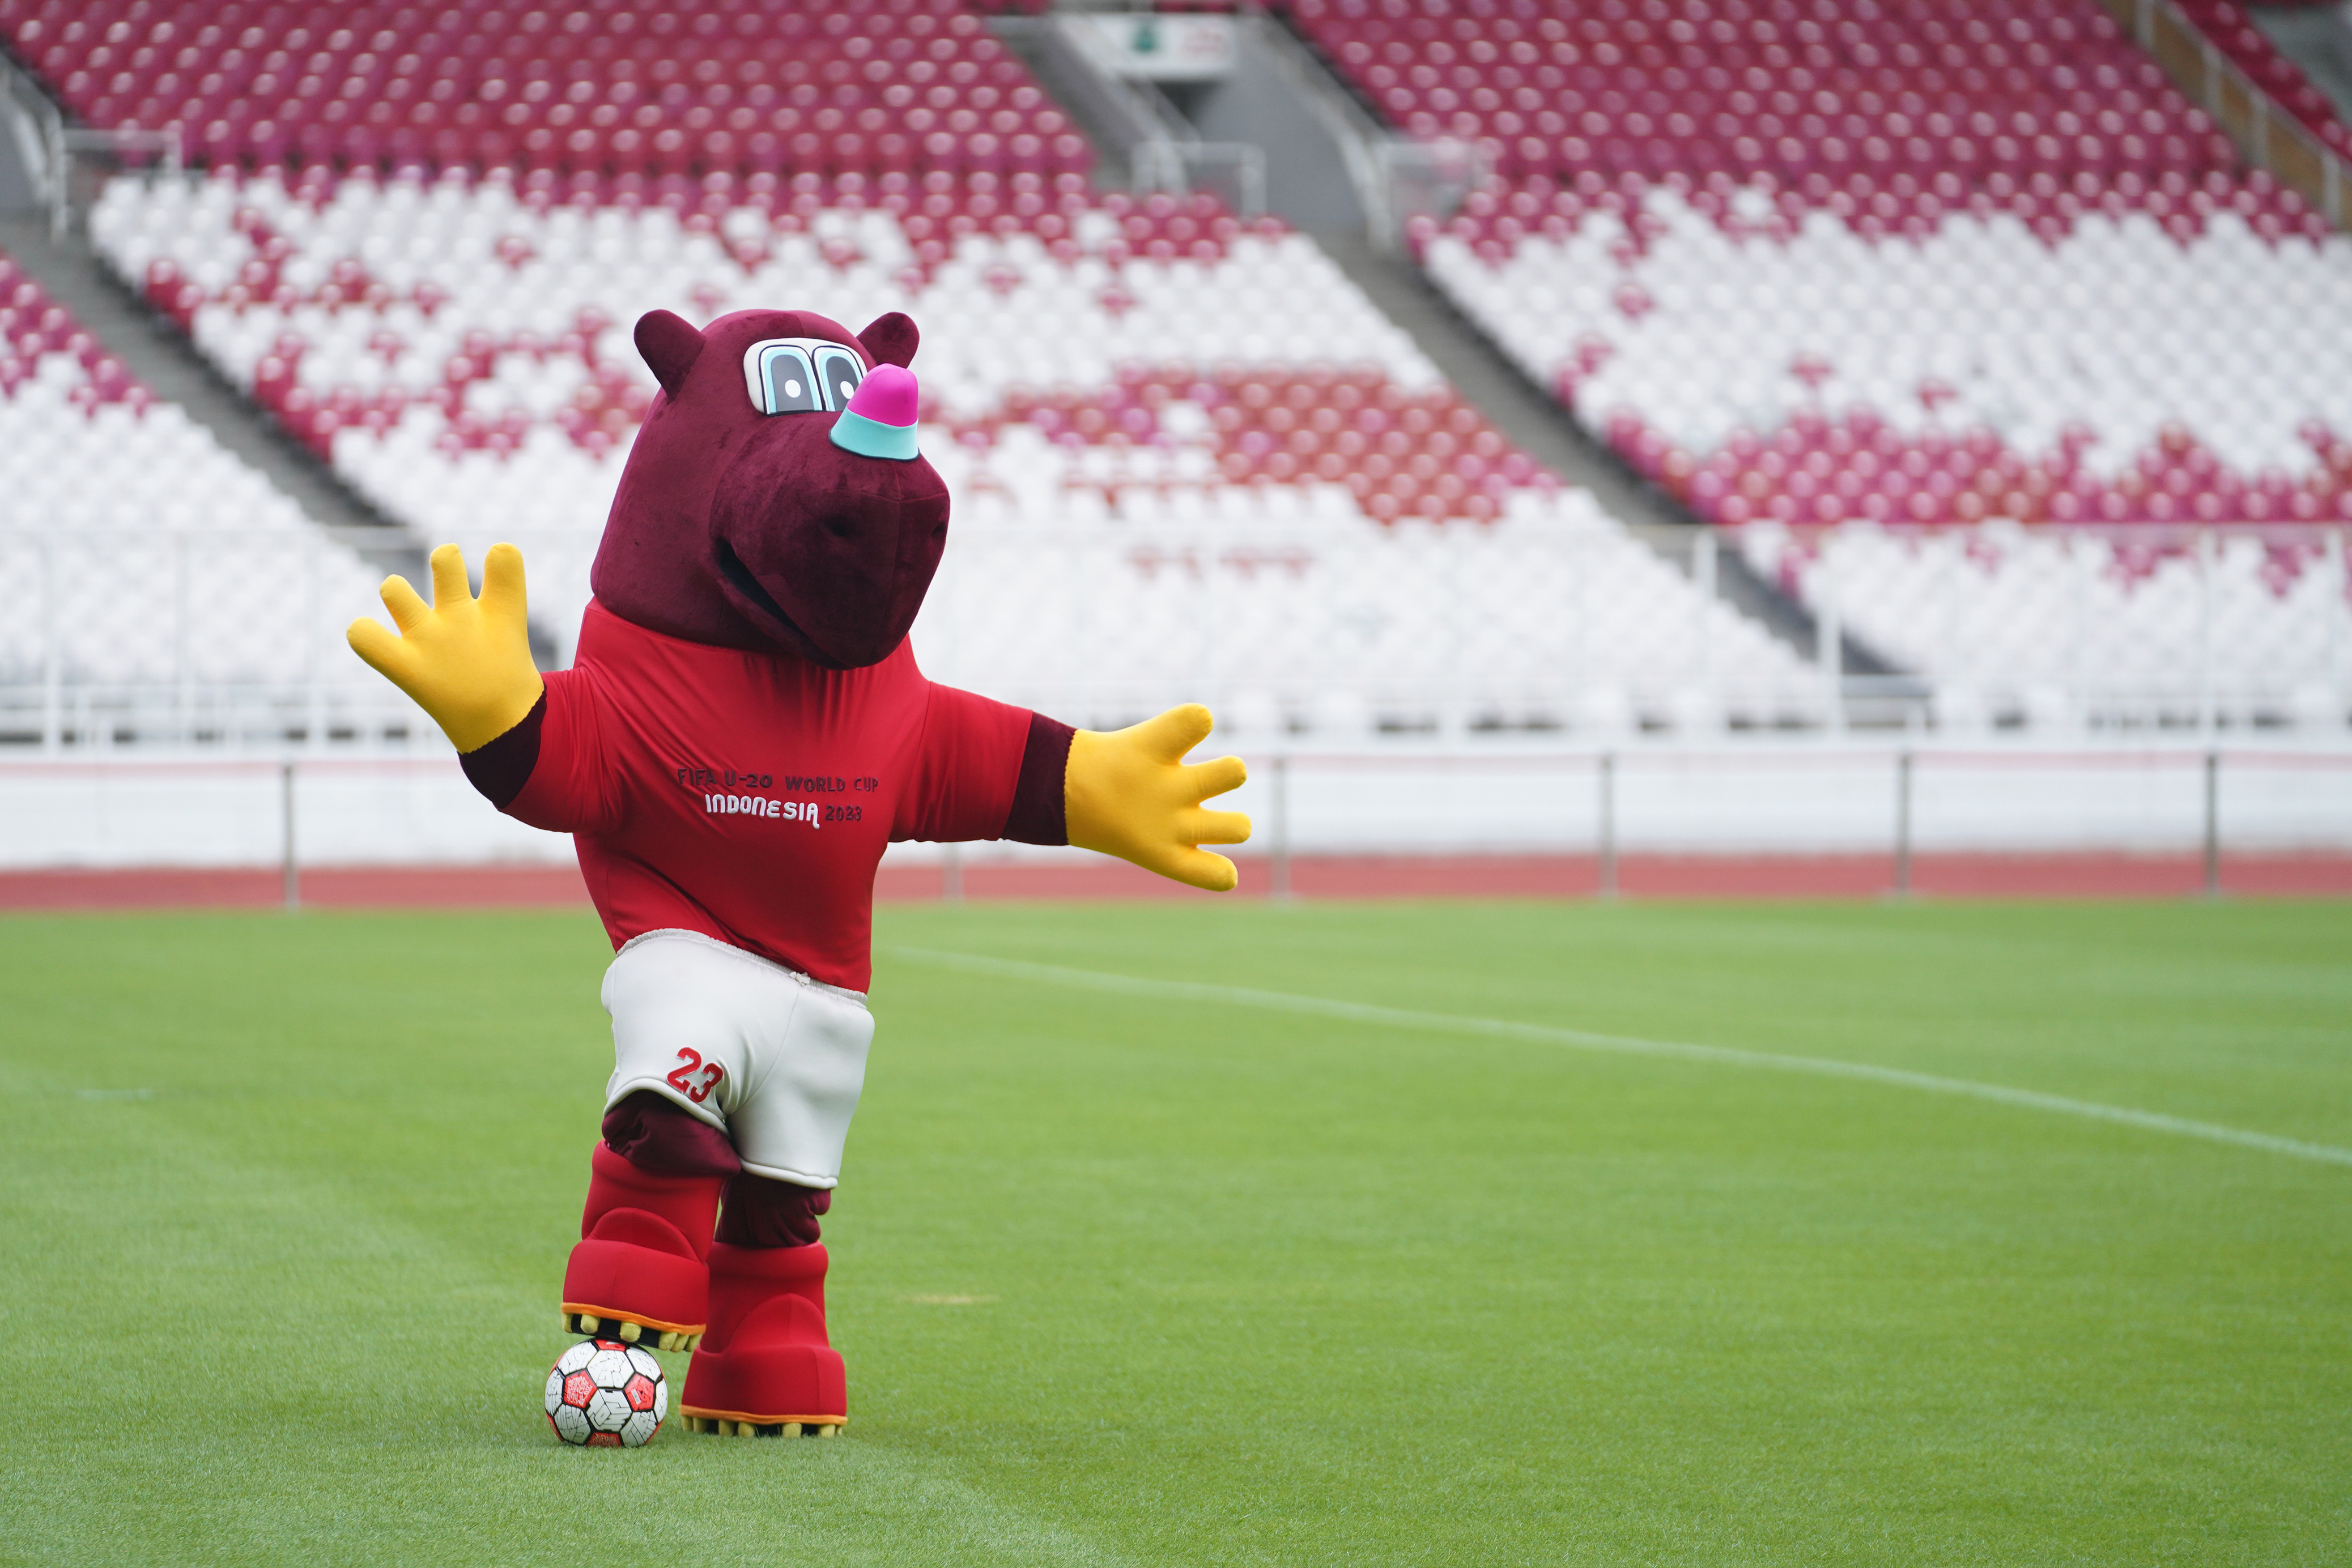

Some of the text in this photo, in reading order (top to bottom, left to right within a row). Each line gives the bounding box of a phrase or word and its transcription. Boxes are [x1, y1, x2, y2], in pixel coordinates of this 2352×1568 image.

[677, 768, 878, 792] FIFA U-20 WORLD CUP
[705, 793, 862, 829] INDONESIA 2023
[666, 1046, 724, 1103] 23
